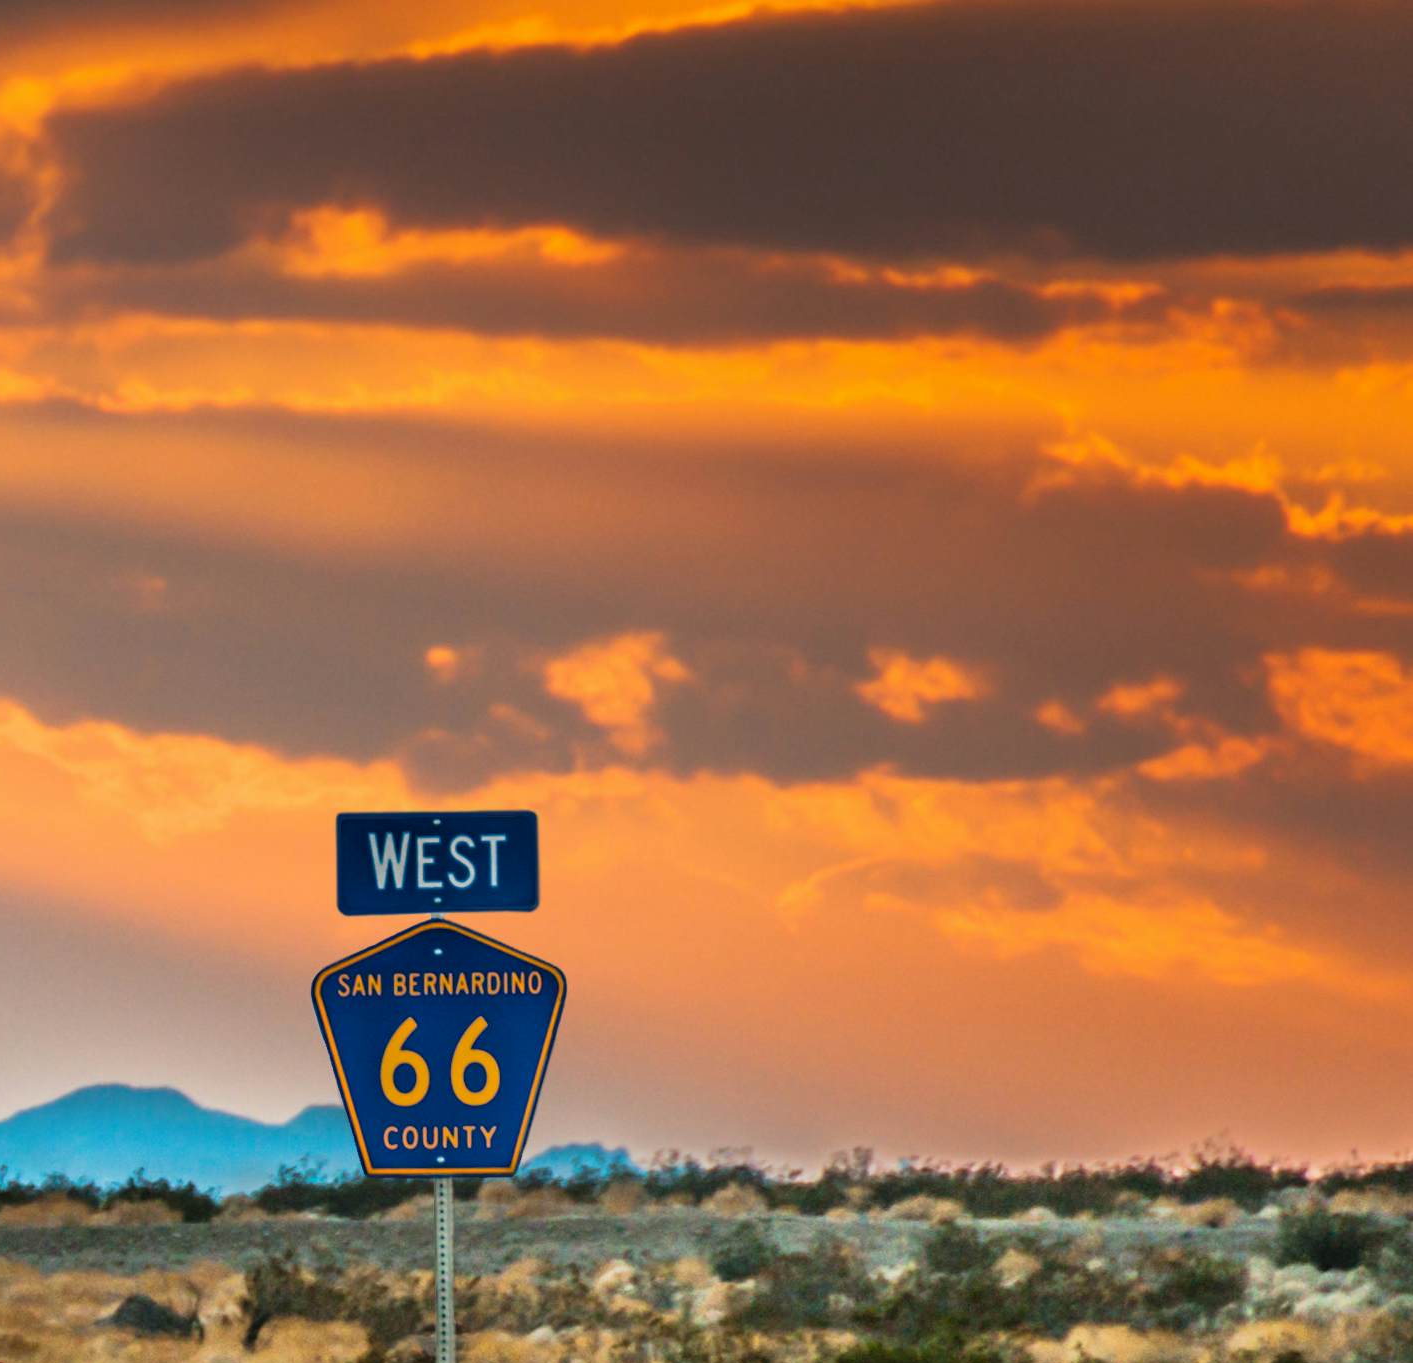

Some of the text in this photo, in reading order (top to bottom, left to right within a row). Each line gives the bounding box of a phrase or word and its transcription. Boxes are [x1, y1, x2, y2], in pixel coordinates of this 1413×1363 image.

[368, 832, 507, 890] WEST
[337, 971, 542, 997] SAN BERNARDINO
[380, 1015, 501, 1107] 66
[382, 1125, 497, 1151] COUNTY
